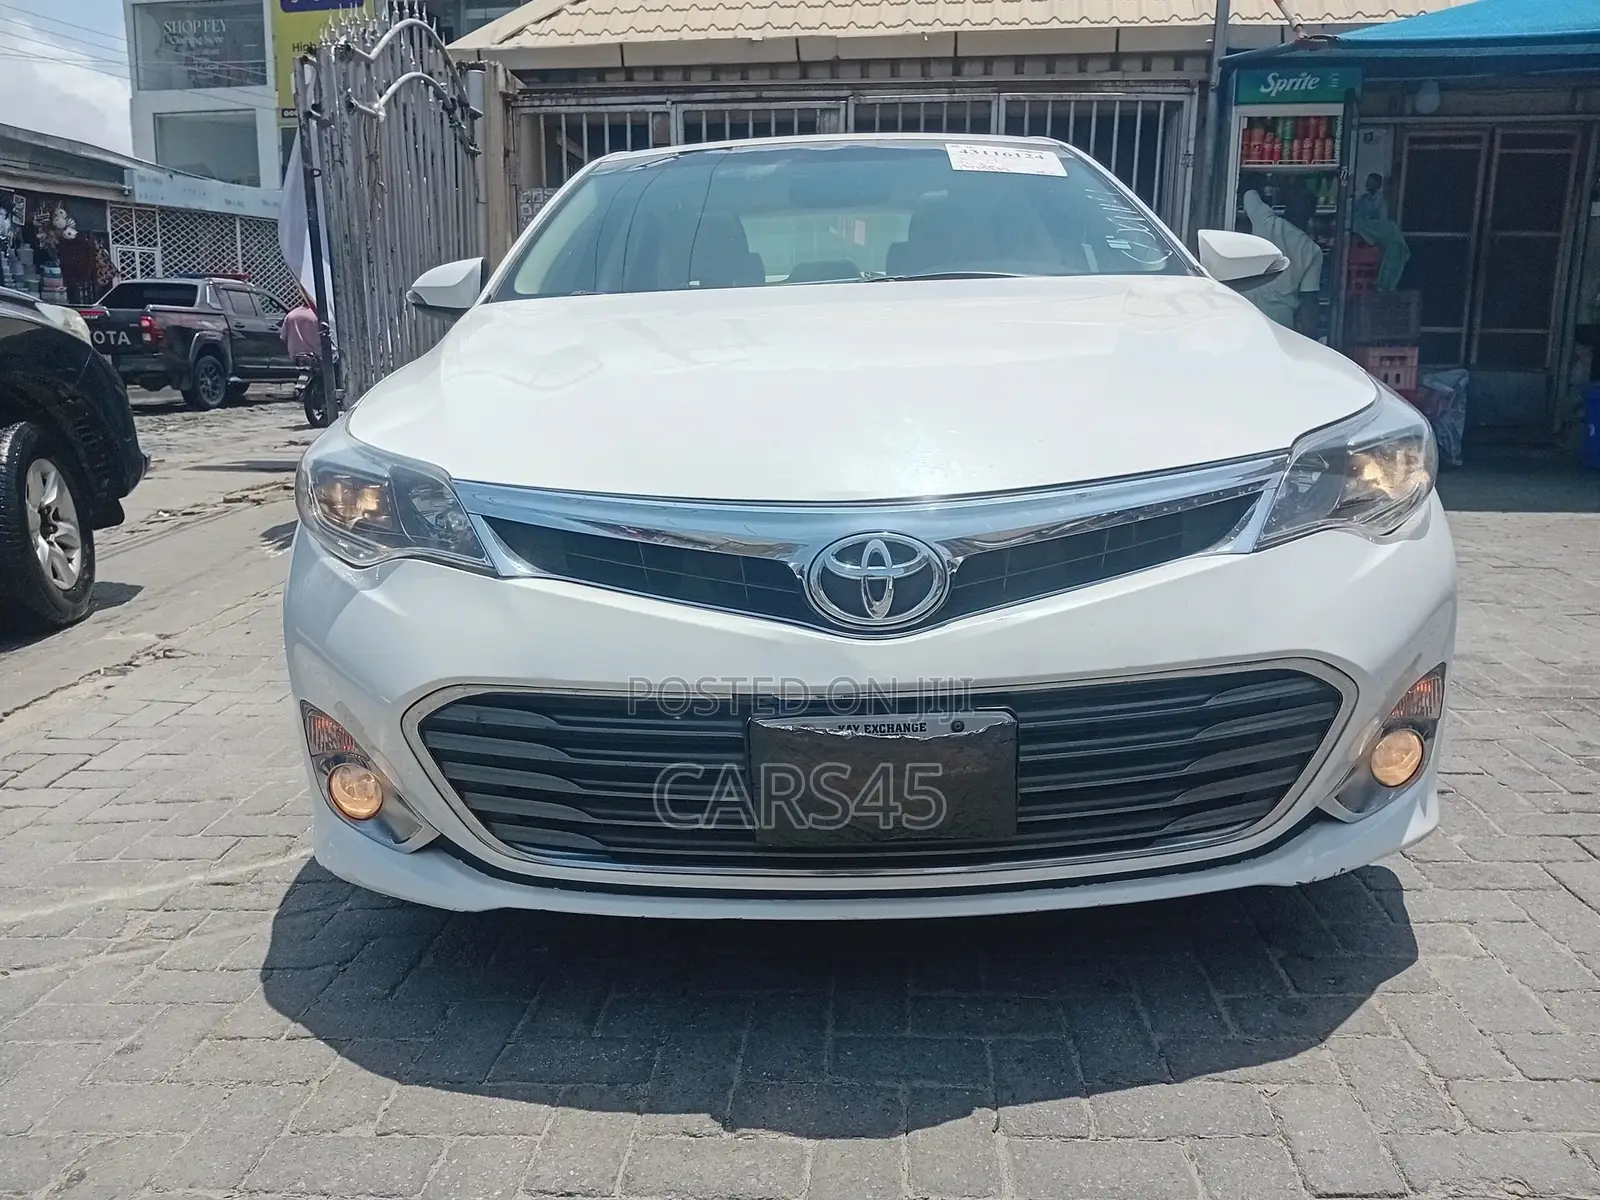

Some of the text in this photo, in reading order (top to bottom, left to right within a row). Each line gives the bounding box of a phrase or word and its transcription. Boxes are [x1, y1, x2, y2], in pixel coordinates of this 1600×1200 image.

[163, 19, 202, 34] SHOP
[1259, 71, 1321, 97] Sprite
[864, 722, 927, 734] EXCHANGE
